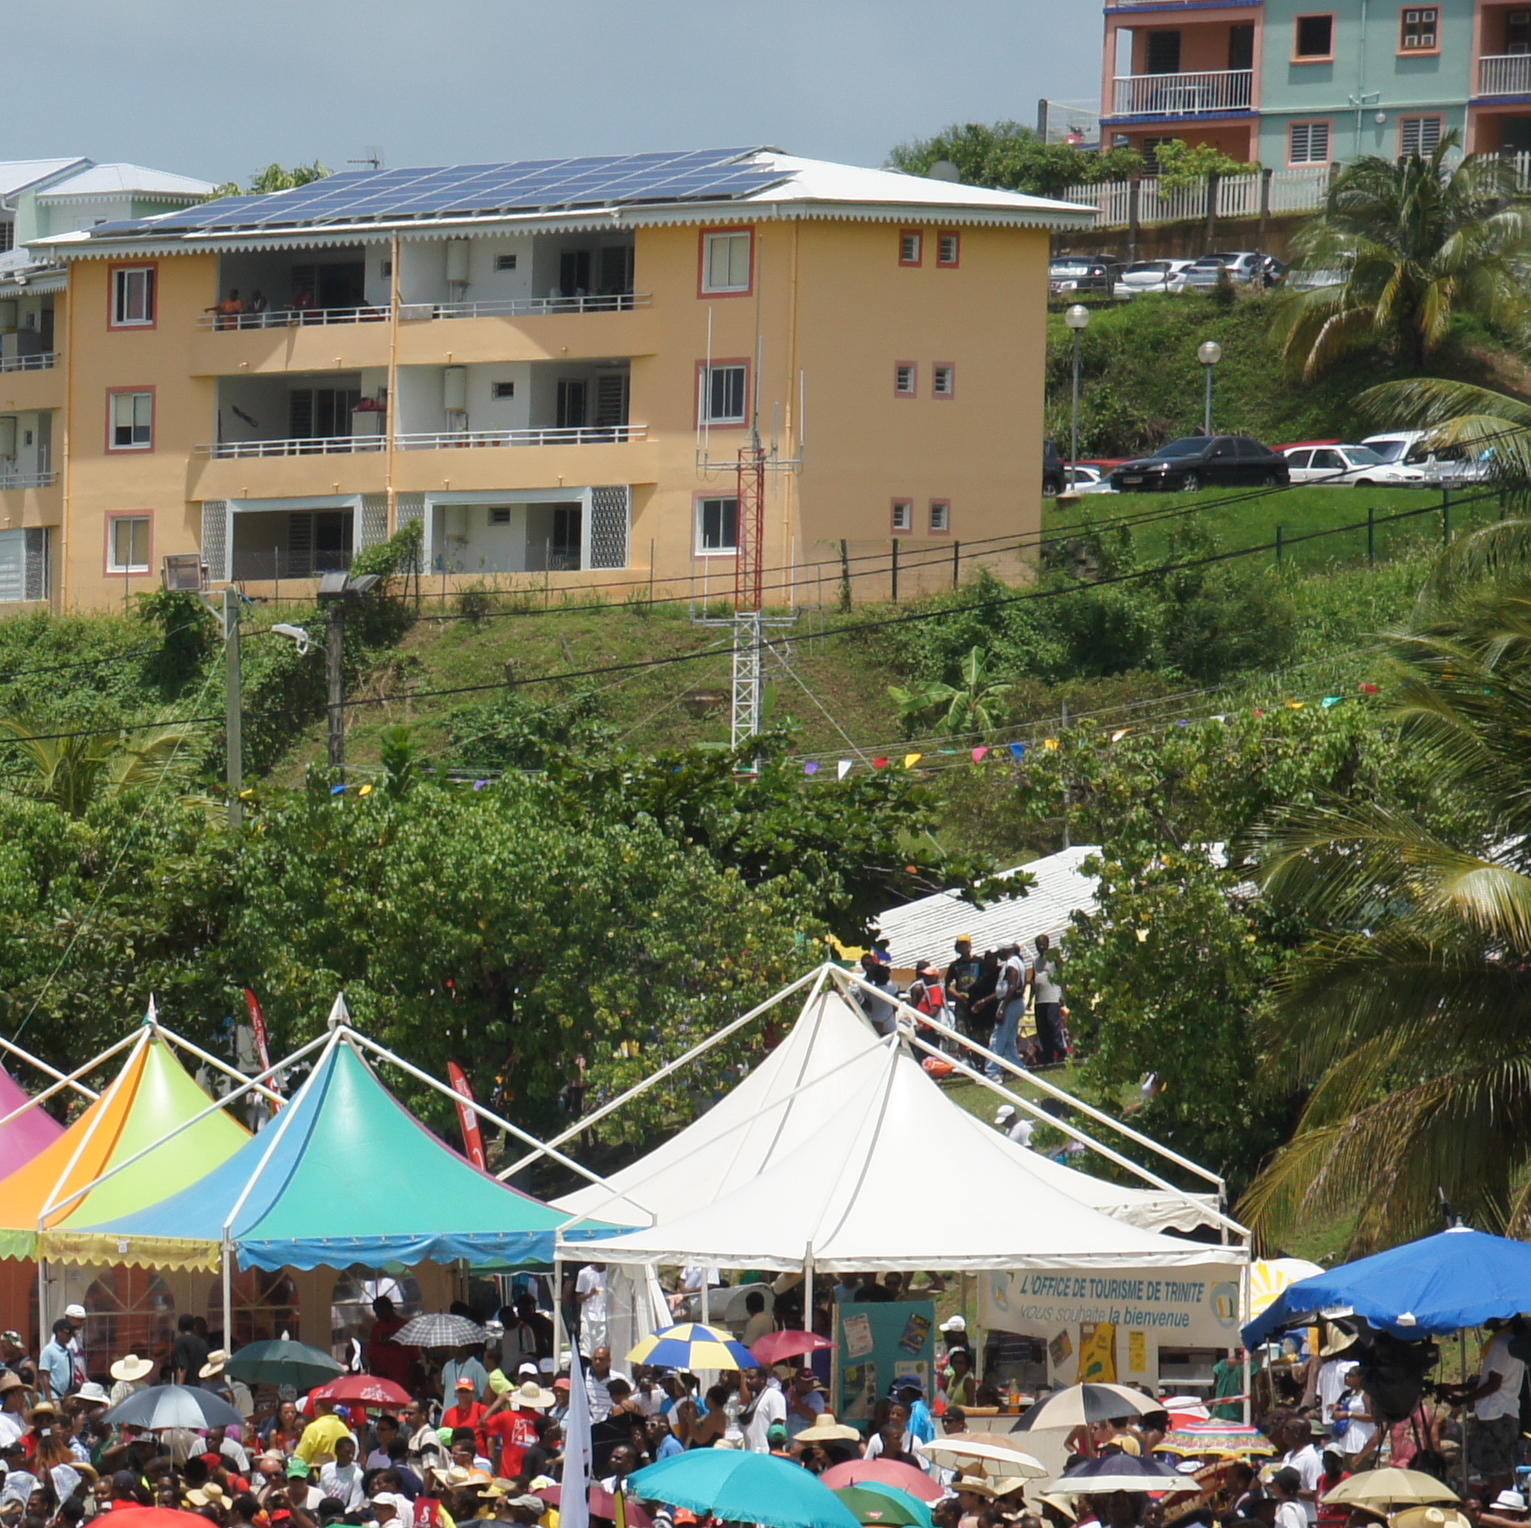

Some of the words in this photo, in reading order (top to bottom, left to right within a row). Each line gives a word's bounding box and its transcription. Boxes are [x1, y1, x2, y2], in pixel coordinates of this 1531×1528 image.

[1020, 1275, 1071, 1296] L'OFFICE
[1072, 1278, 1086, 1298] DE
[1089, 1278, 1144, 1301] TOURISME
[1146, 1282, 1161, 1301] DE
[1056, 1303, 1106, 1323] souhaite
[1108, 1305, 1120, 1322] la
[1124, 1305, 1190, 1328] bienvenue
